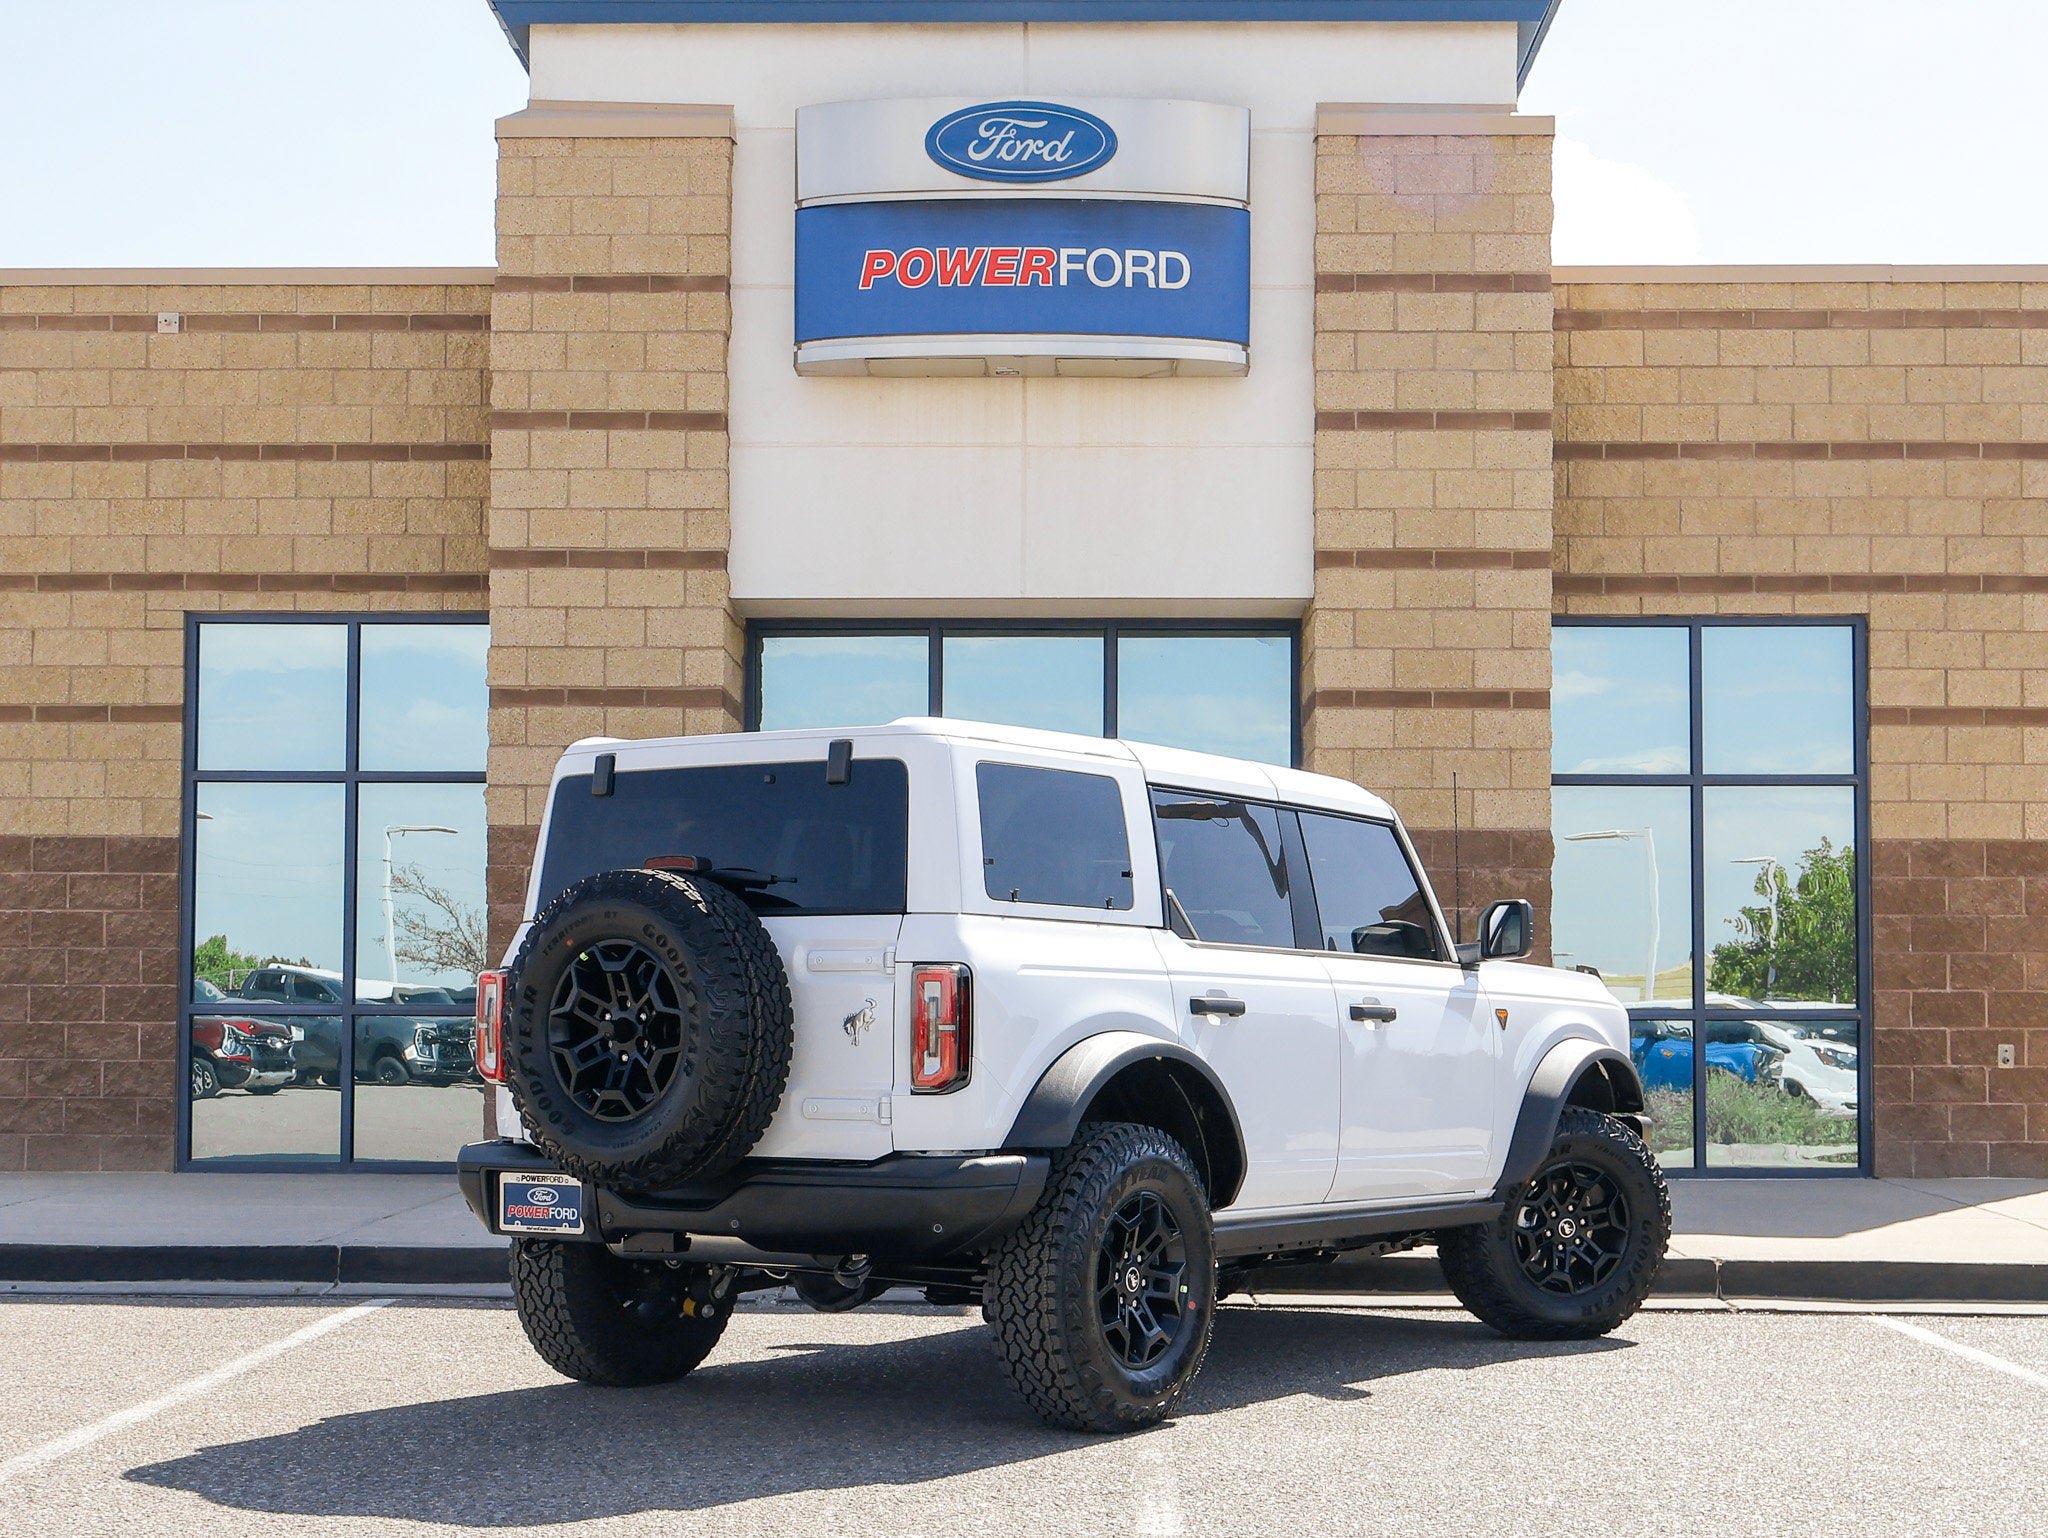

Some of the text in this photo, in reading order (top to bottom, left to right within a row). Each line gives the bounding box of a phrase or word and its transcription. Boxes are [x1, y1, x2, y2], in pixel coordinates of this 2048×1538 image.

[967, 117, 1074, 162] Ford
[858, 247, 1192, 290] POWERFORD
[521, 1175, 564, 1183] POWERFORD
[533, 1190, 553, 1202] Ford
[508, 1205, 577, 1220] POWERFORD
